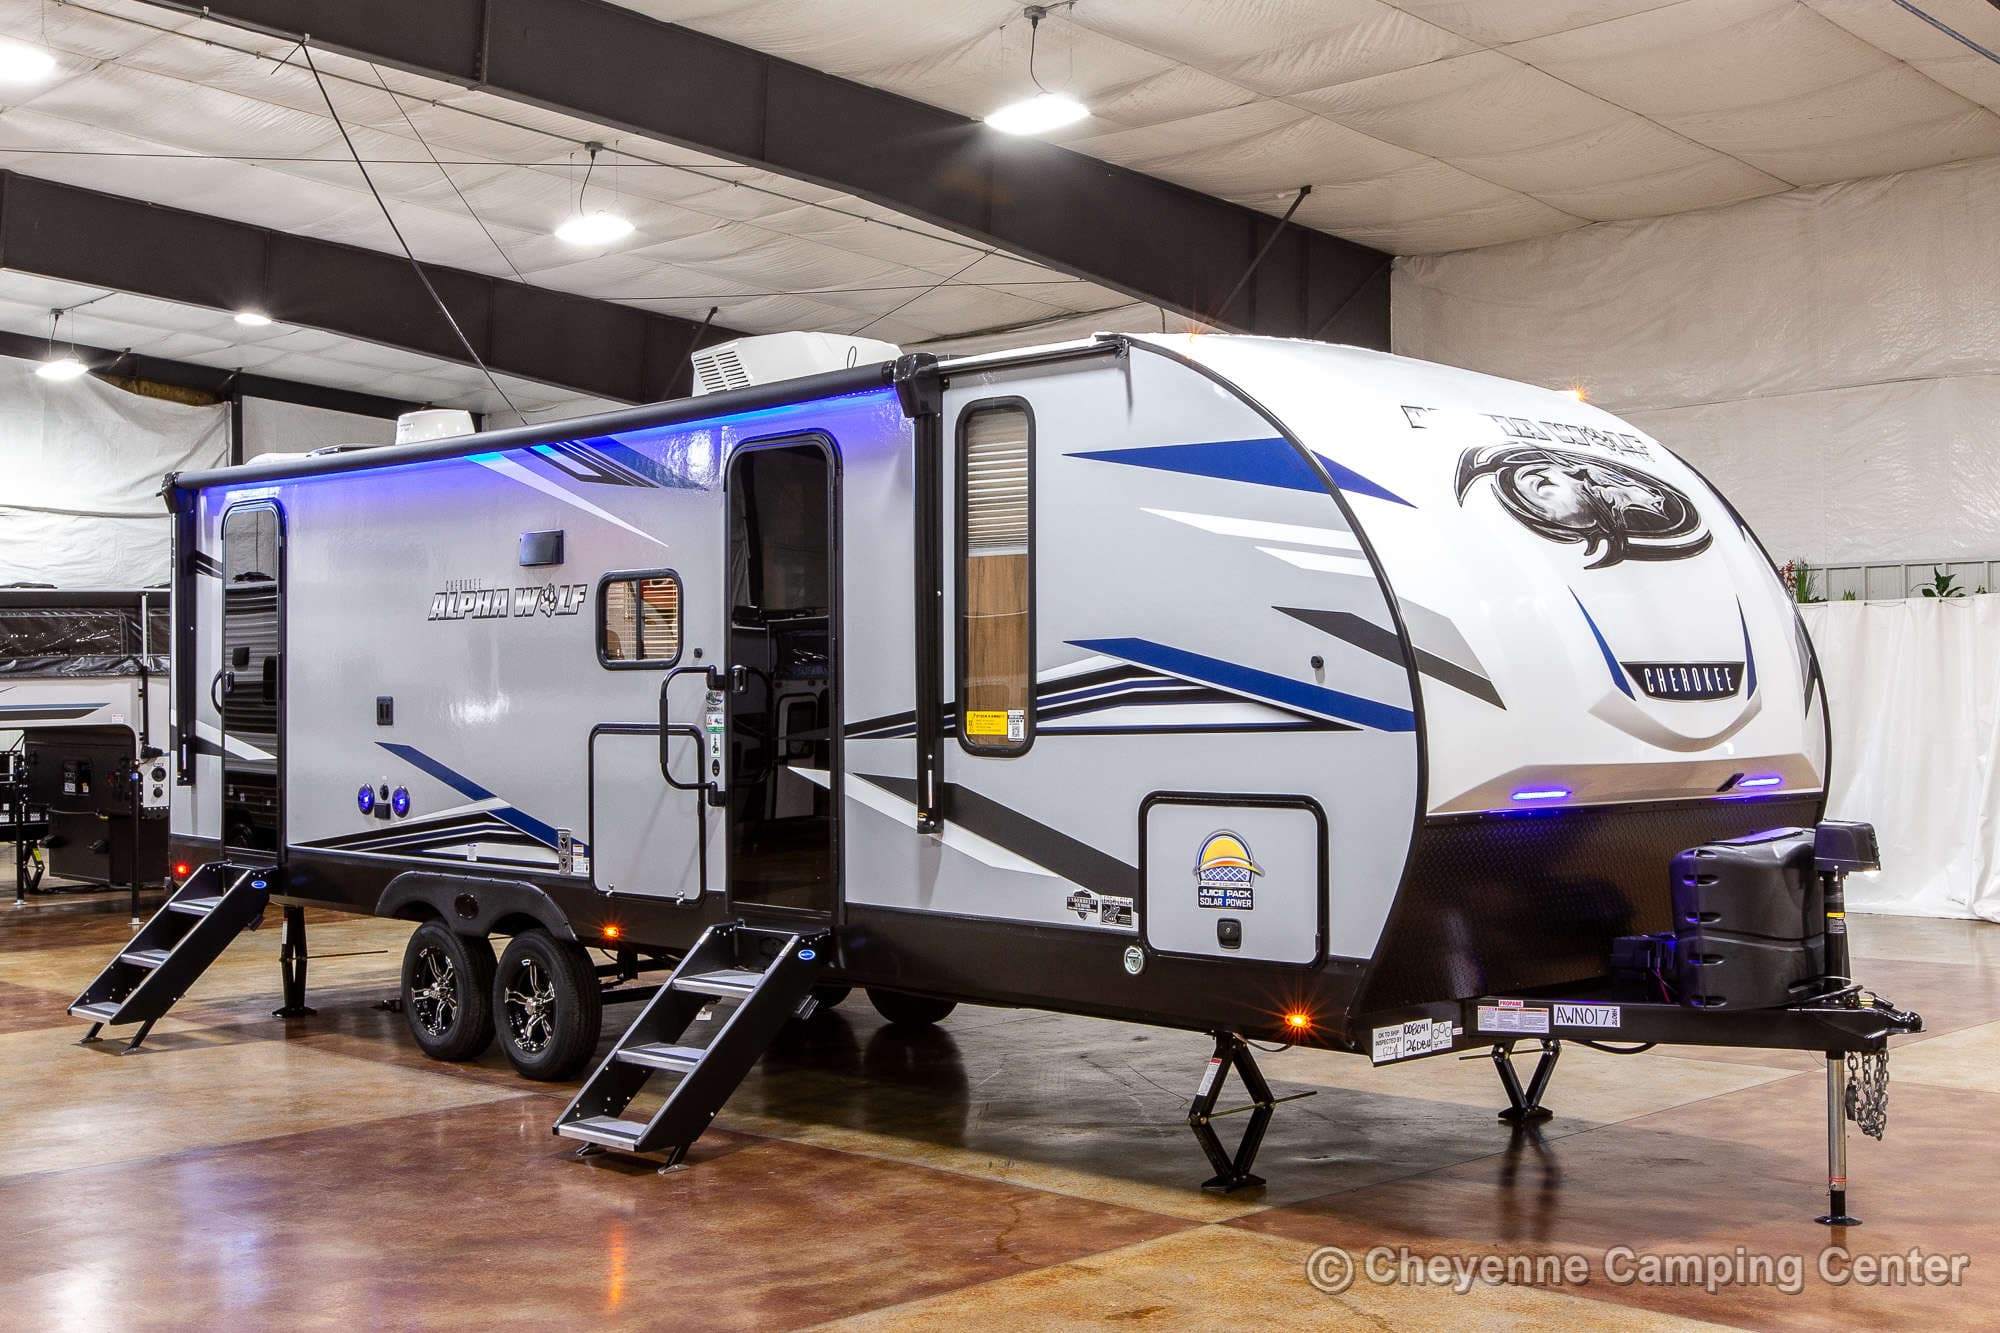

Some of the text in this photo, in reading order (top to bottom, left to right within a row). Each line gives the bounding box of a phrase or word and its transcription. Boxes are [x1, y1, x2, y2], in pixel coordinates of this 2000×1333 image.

[428, 588, 510, 620] ALPHA
[1644, 667, 1734, 692] CHEROKEE
[1199, 898, 1252, 907] SOLAR POWER
